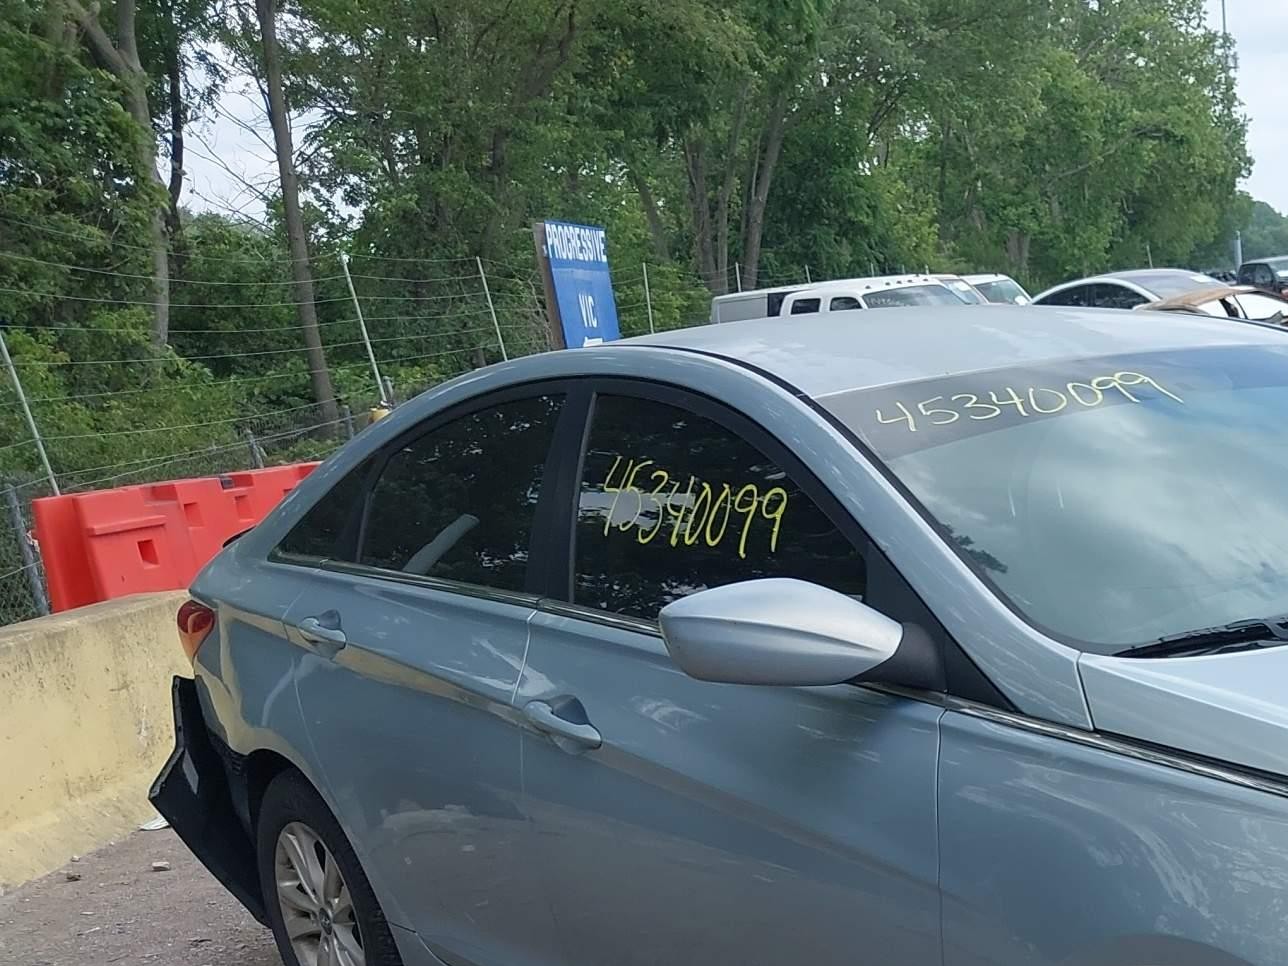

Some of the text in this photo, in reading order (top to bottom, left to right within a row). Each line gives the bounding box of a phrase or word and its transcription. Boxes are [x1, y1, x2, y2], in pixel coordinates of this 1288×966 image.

[545, 223, 608, 263] PROGRESSIVE
[578, 293, 598, 328] VIC
[875, 370, 1185, 432] 45340099
[602, 455, 789, 559] 45340099
